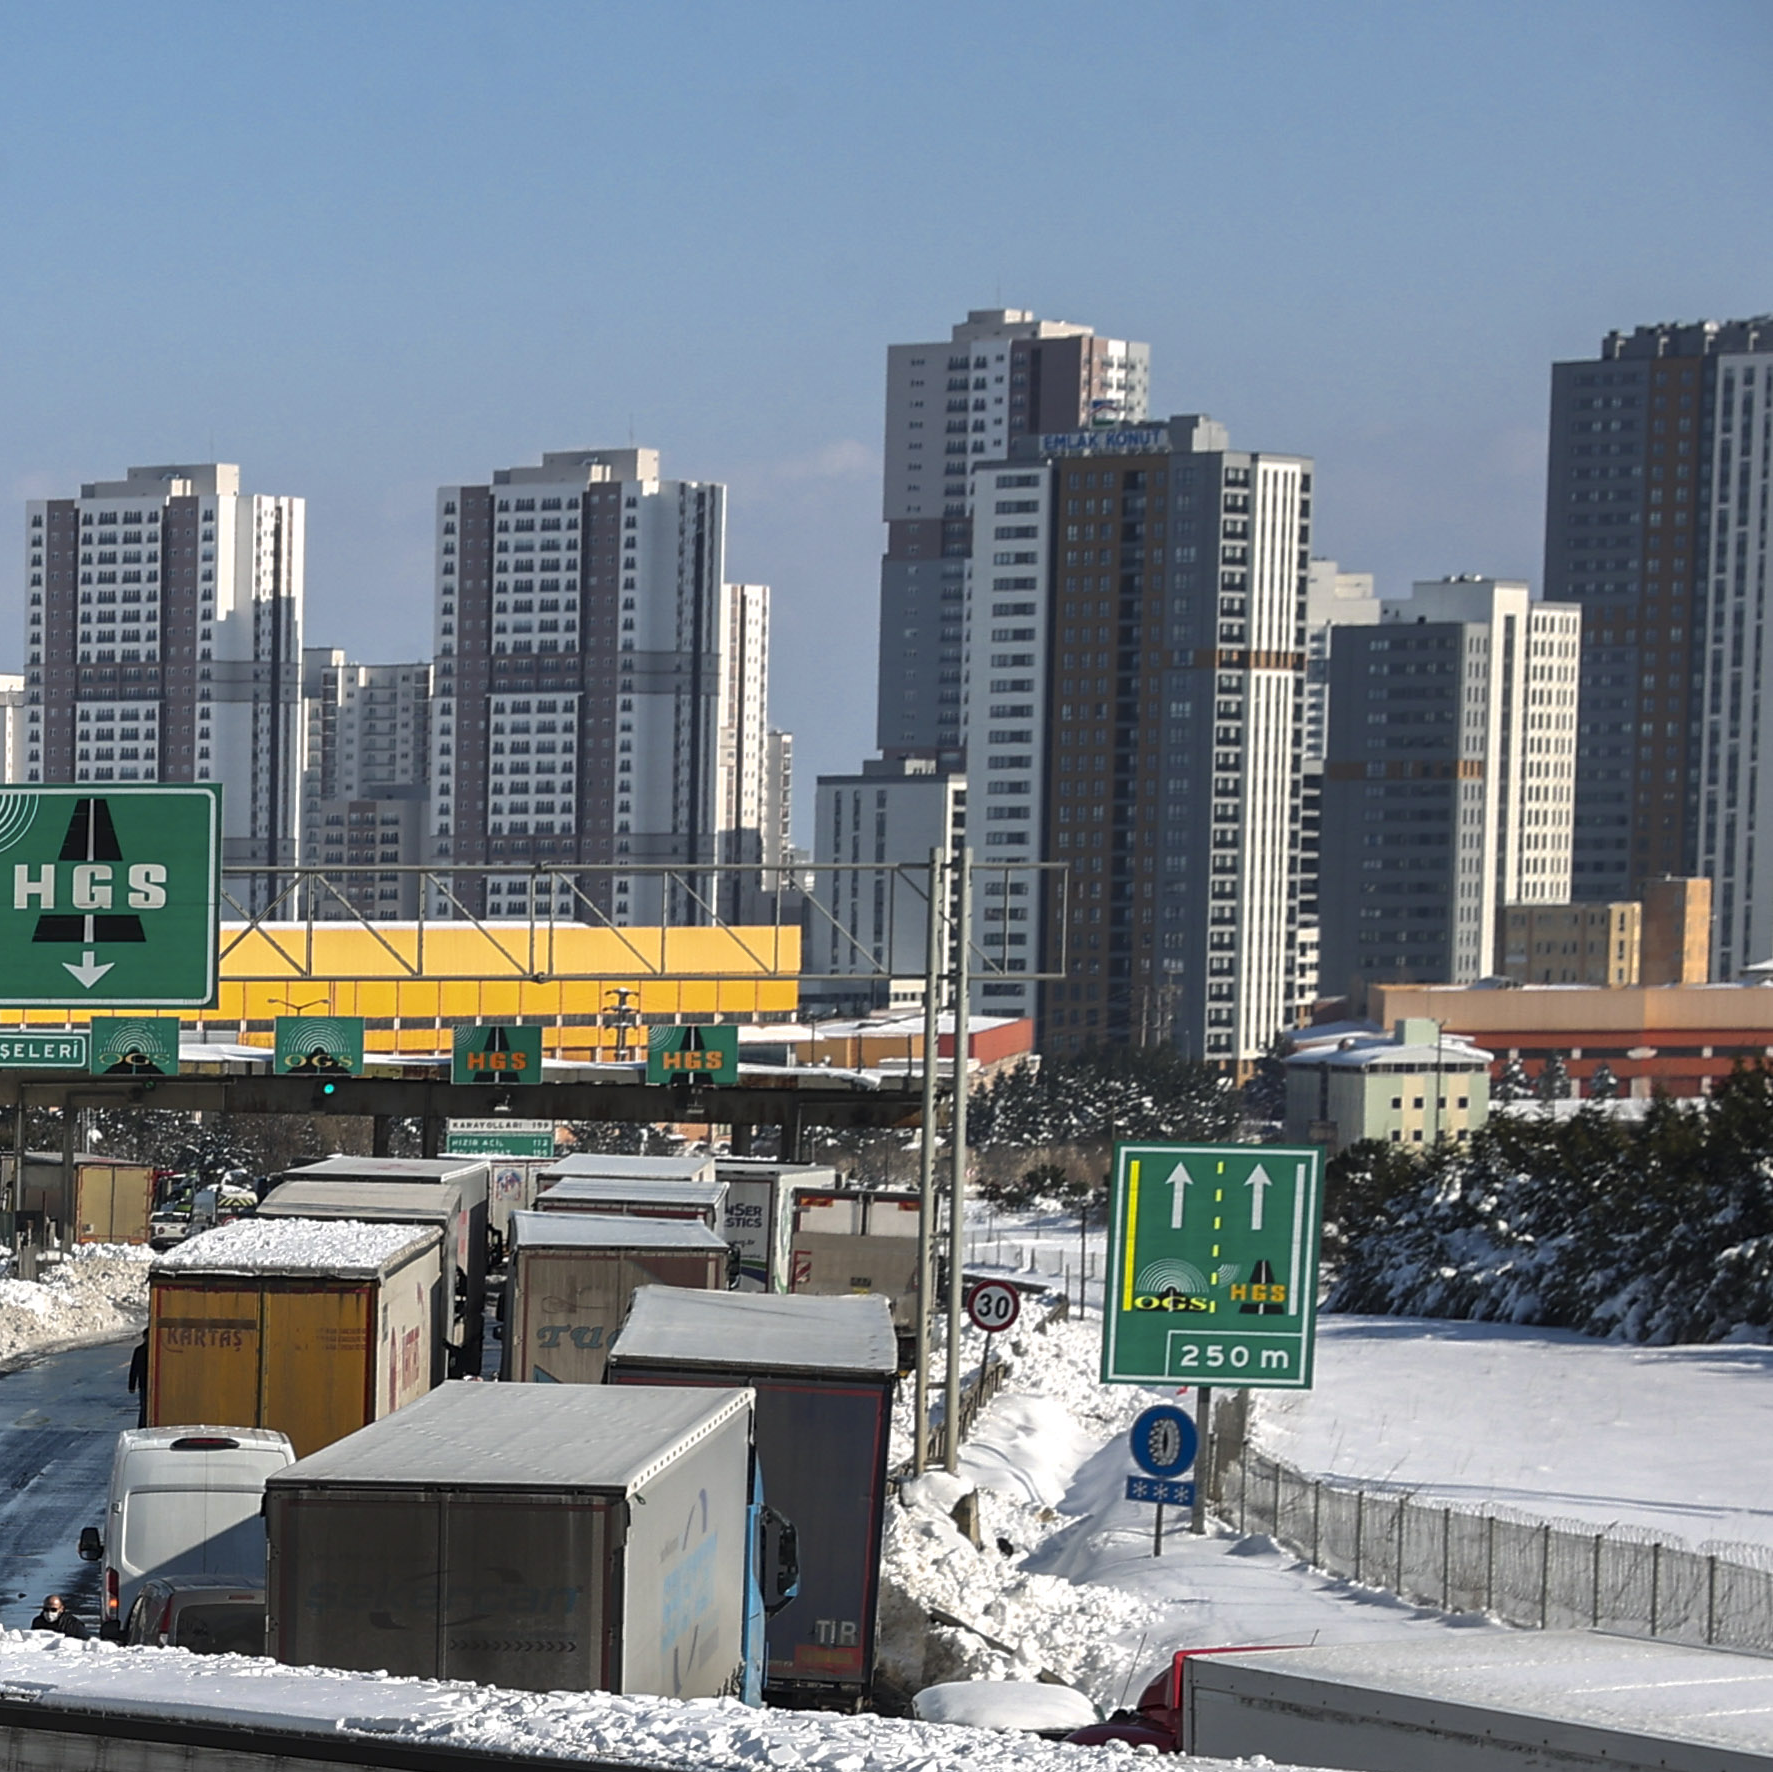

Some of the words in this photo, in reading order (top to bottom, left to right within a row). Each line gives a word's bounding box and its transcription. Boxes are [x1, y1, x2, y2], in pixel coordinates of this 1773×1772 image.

[14, 864, 167, 909] HGS
[284, 1053, 353, 1068] OGS
[467, 1051, 527, 1070] HGS
[663, 1051, 723, 1070] HGS
[1230, 1284, 1286, 1302] HGS
[977, 1293, 1010, 1319] 30
[1134, 1295, 1208, 1311] OGS
[1180, 1344, 1250, 1368] 250
[1260, 1349, 1289, 1369] m
[815, 1619, 857, 1645] TIR
